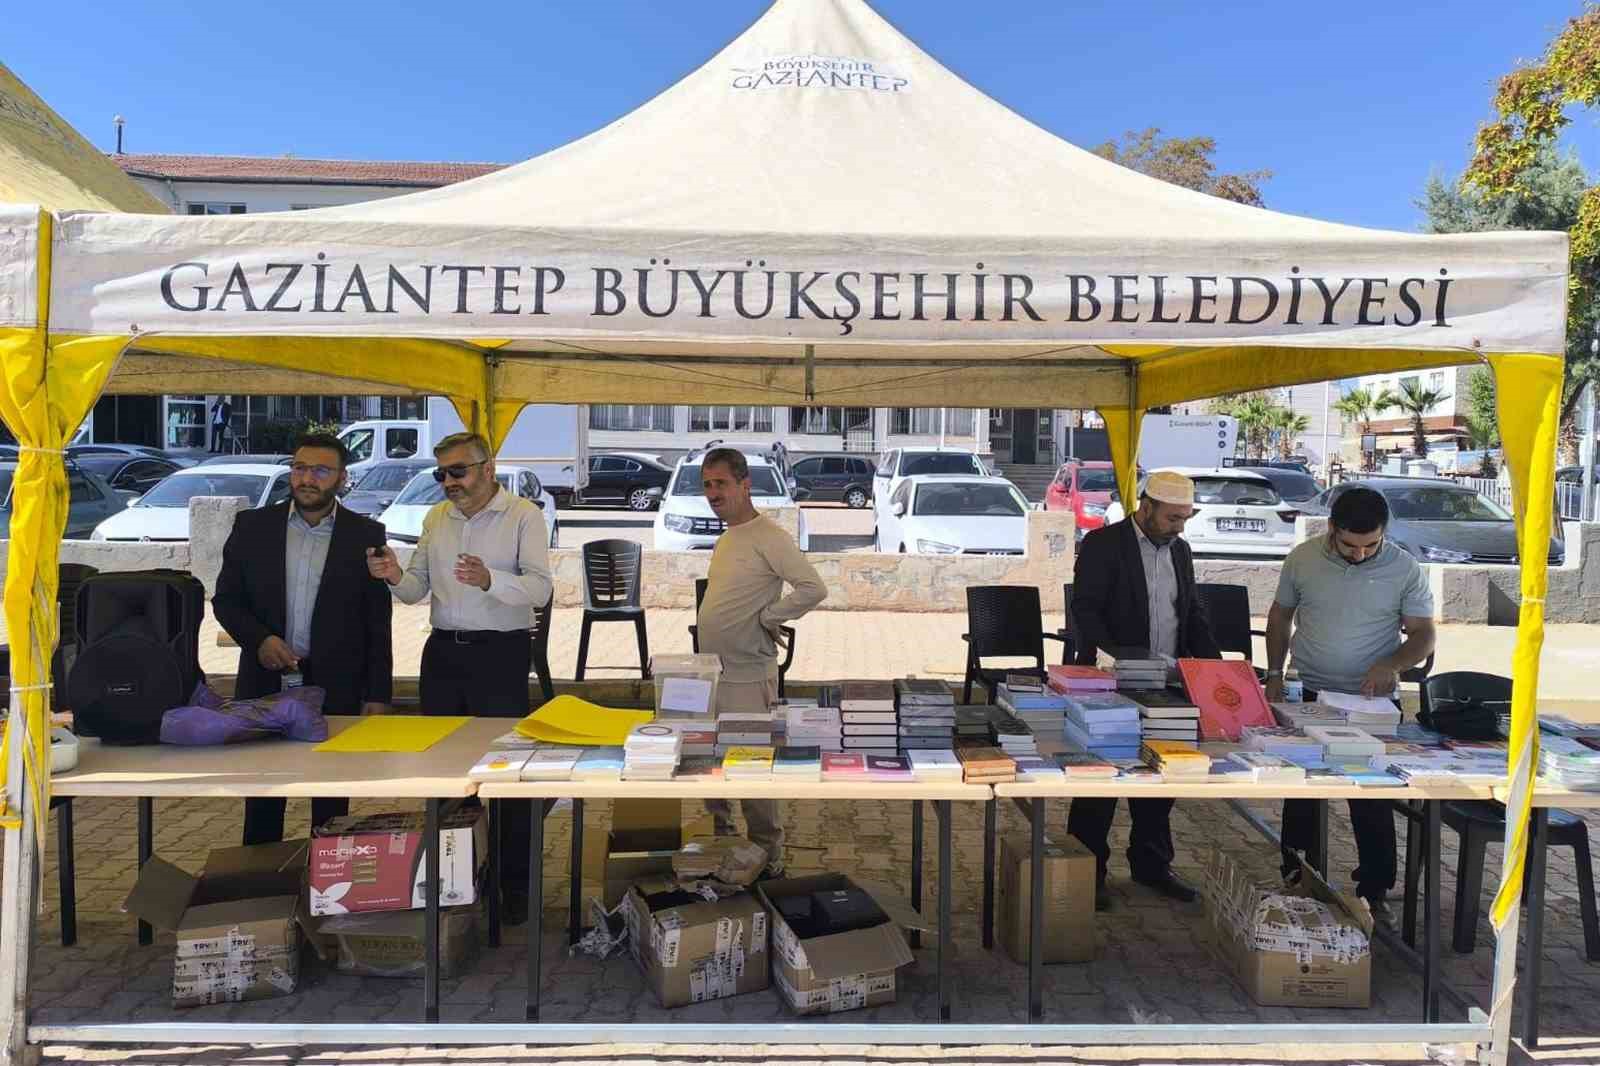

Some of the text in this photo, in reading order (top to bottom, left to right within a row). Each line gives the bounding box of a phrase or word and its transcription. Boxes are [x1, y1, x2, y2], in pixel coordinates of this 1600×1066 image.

[161, 253, 1454, 336] GAZİANTEP BÜYÜKŞEHİR BELEDİYESİ
